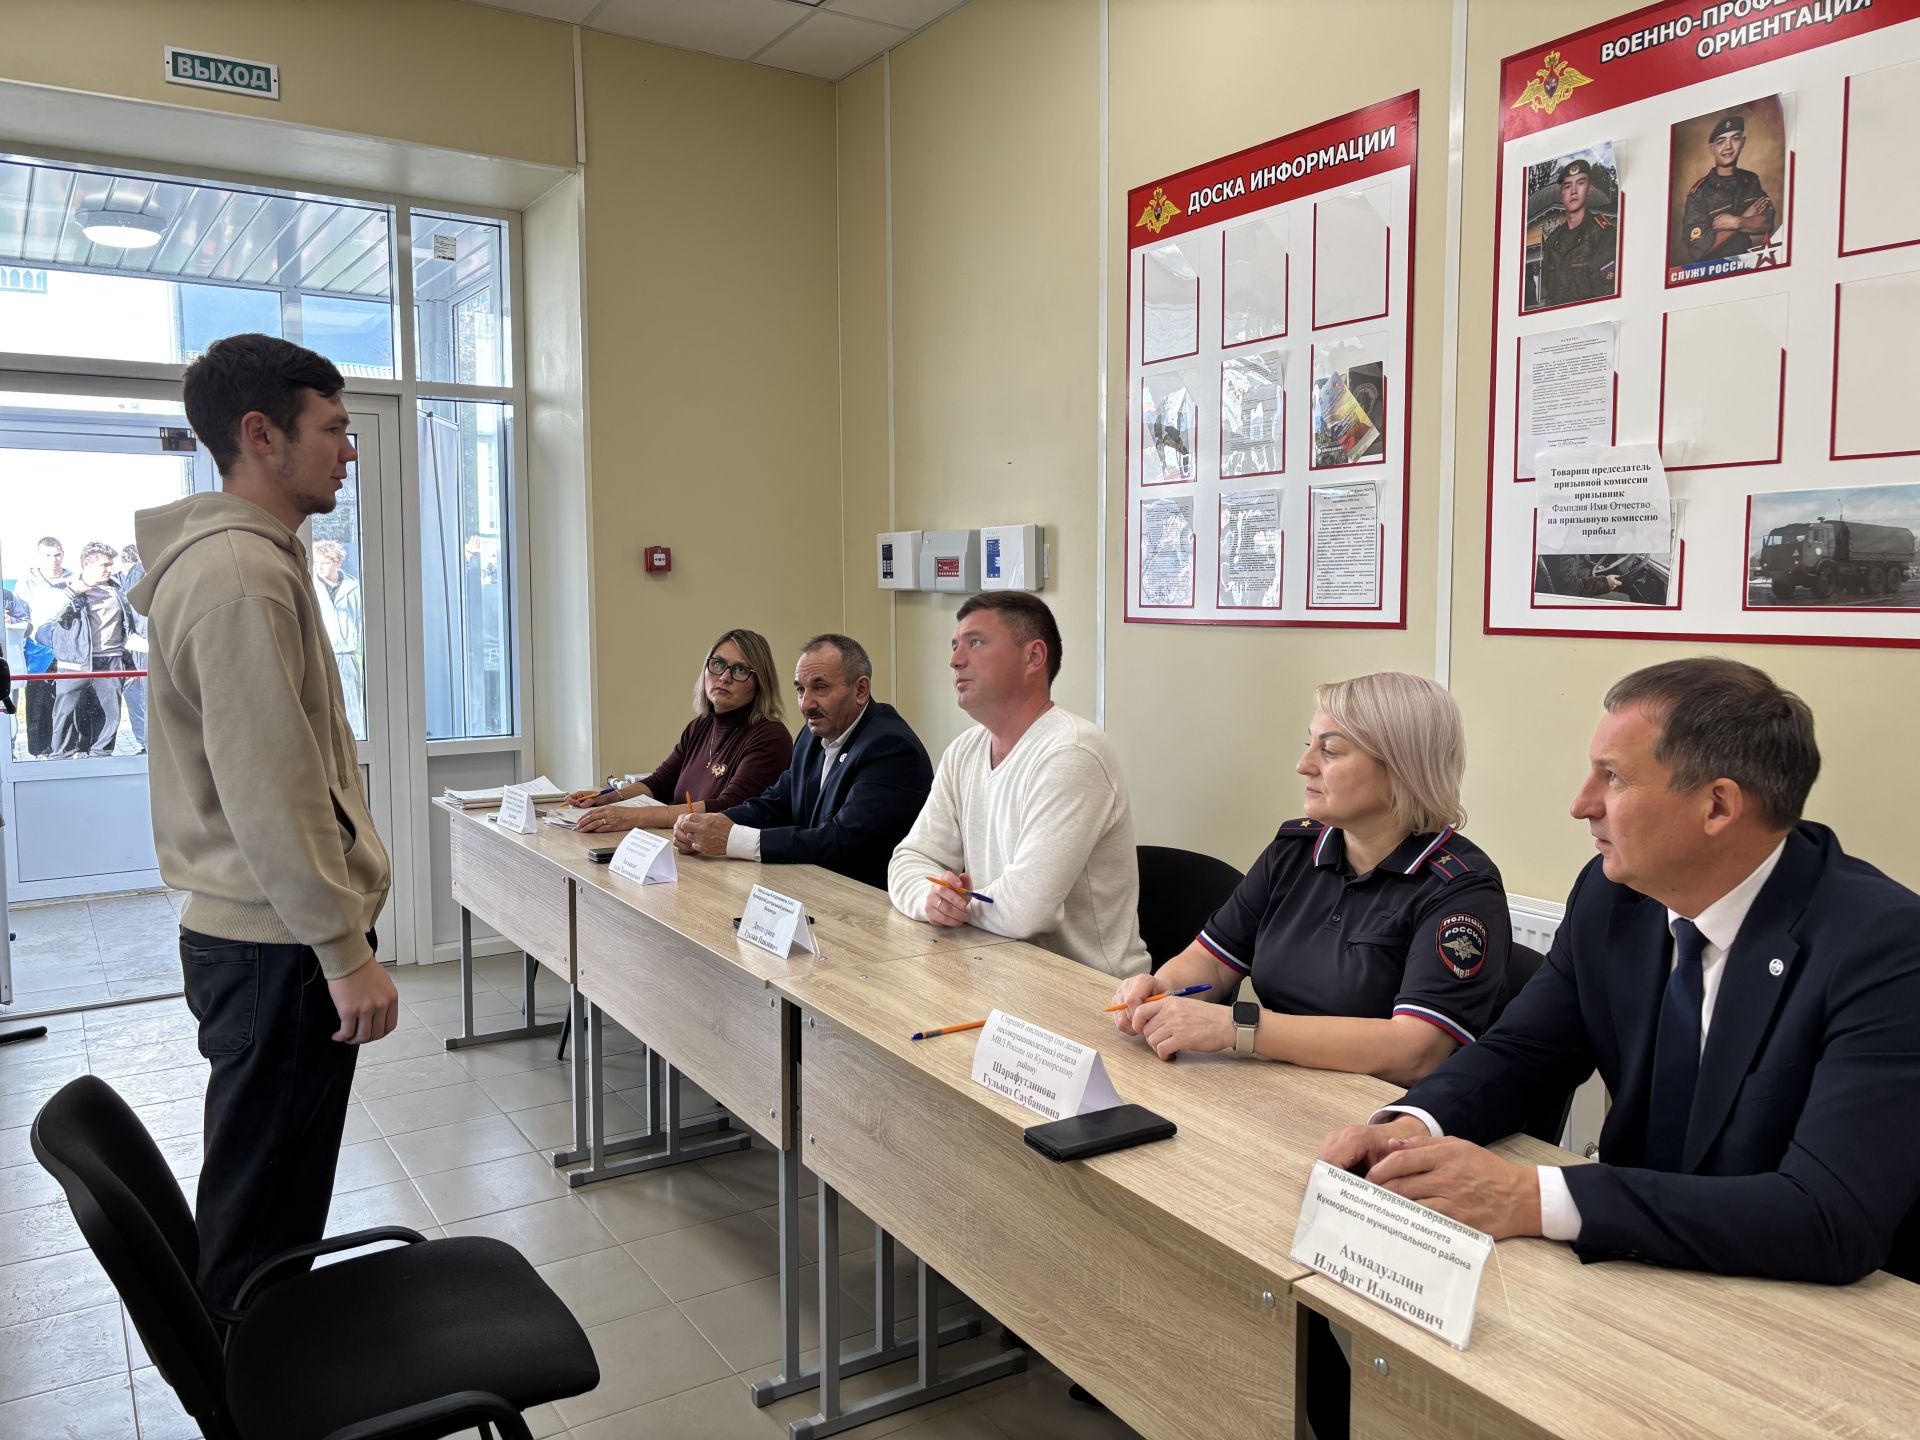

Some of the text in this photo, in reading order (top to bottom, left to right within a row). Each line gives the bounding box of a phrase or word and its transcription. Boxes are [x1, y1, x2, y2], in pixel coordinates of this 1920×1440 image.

[177, 56, 269, 90] ВЫХОД
[1187, 126, 1396, 214] ДОСКА ИНФОРМАЦИИ
[1671, 268, 1705, 282] СЛУЖУ
[1551, 465, 1651, 477] Товарищ председатель
[1554, 477, 1648, 489] призывной комиссии
[1575, 491, 1624, 500] призывник
[1552, 502, 1650, 512] Фамилия Имя Отчество
[1560, 517, 1608, 526] призывную
[1612, 514, 1658, 523] комиссию
[1582, 527, 1616, 537] прибыл
[1443, 916, 1486, 937] ПОЛИЦИЯ
[1445, 927, 1482, 946] РОССИЯ
[1453, 965, 1470, 978] МВД
[991, 1034, 1006, 1048] МВД
[1005, 1040, 1026, 1056] России
[1016, 1059, 1037, 1074] району
[993, 1061, 1056, 1101] Шарафутдинова
[983, 1073, 1060, 1120] Гульназ Саубановна
[1327, 1168, 1480, 1240] Начальник Управления образования
[1340, 1189, 1452, 1244] Исполнительного комитета
[1316, 1193, 1472, 1271] Кукморского муниципального района
[1339, 1244, 1424, 1295] Ахмадуллин
[1314, 1253, 1444, 1330] Ильфат Ильясович
